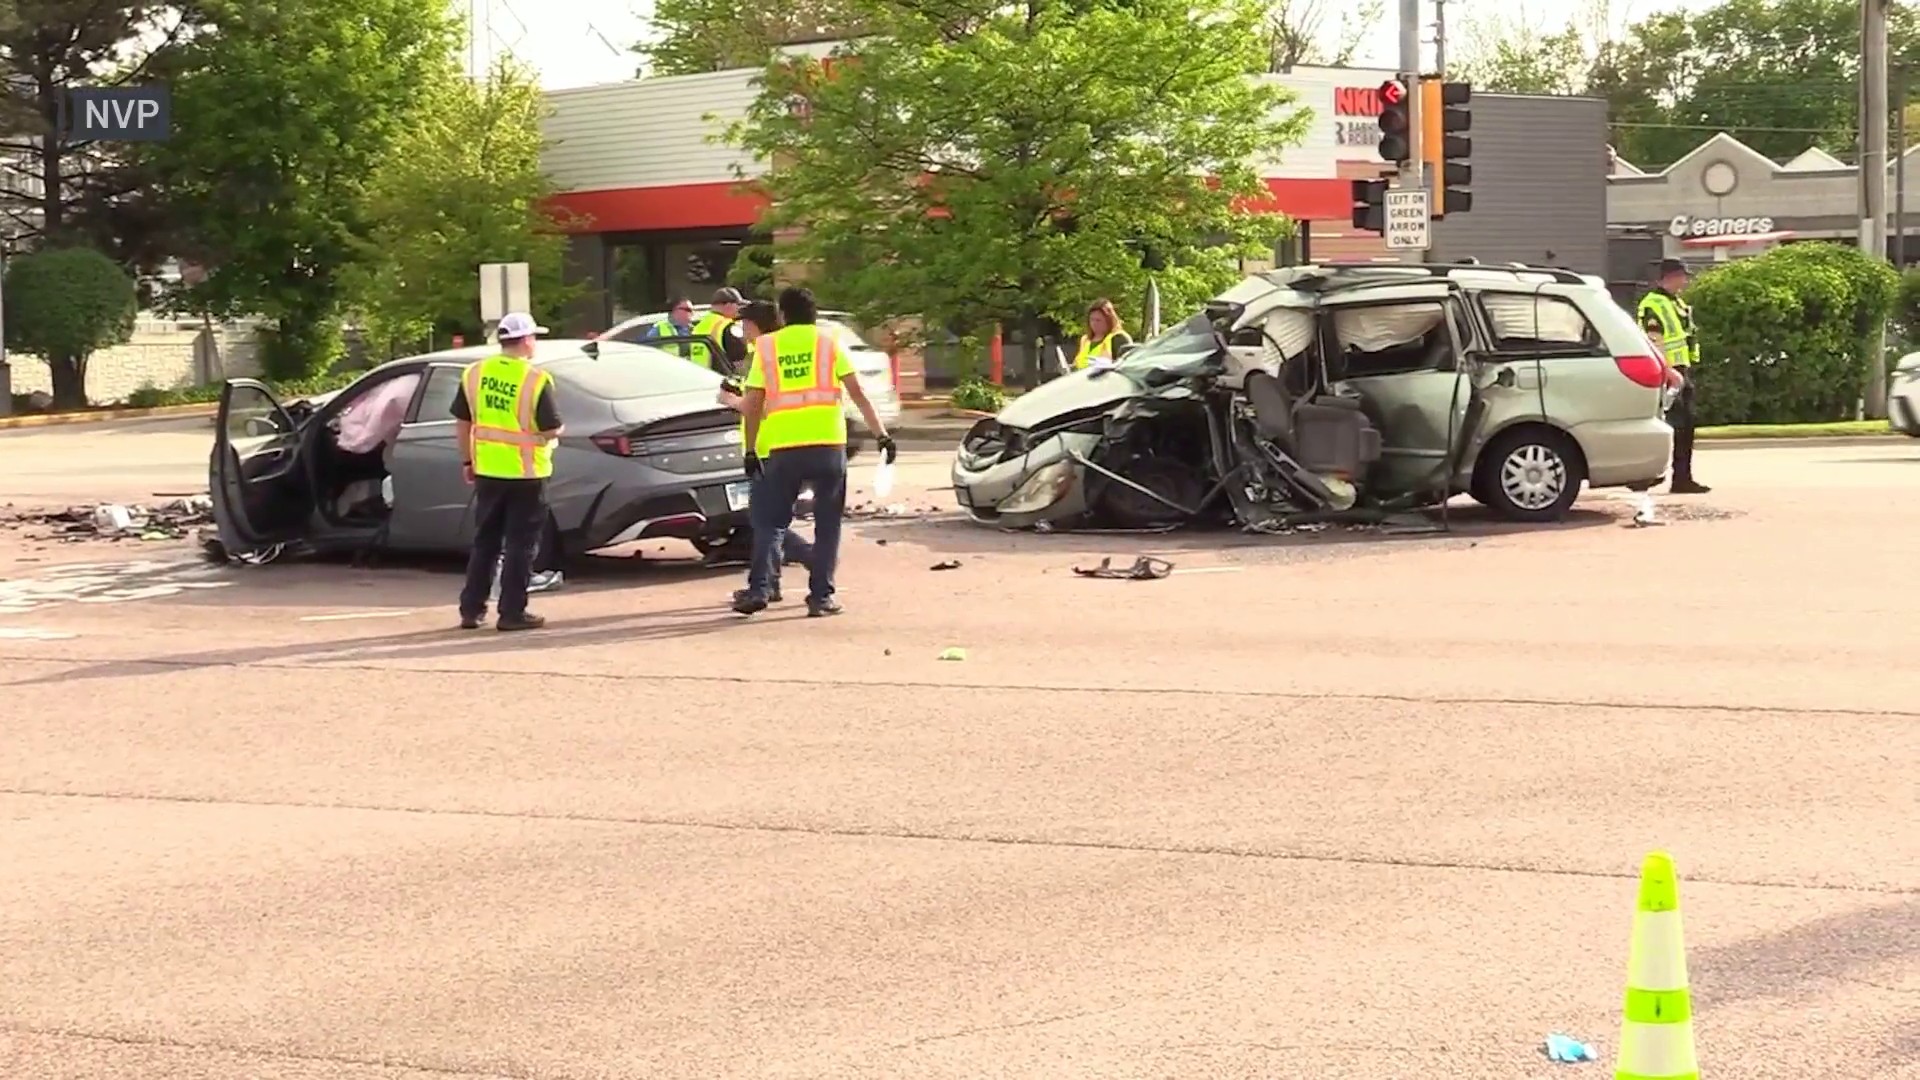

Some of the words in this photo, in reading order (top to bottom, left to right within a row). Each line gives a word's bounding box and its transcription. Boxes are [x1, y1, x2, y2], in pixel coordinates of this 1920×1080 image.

[1389, 195, 1408, 205] LEFT
[1412, 194, 1424, 204] ON
[1391, 208, 1423, 218] GREEN
[1390, 222, 1425, 231] ARROW
[1669, 215, 1774, 236] Cleaners
[1393, 236, 1420, 245] ONLY
[778, 352, 812, 367] POLICE
[481, 376, 517, 397] POLICE
